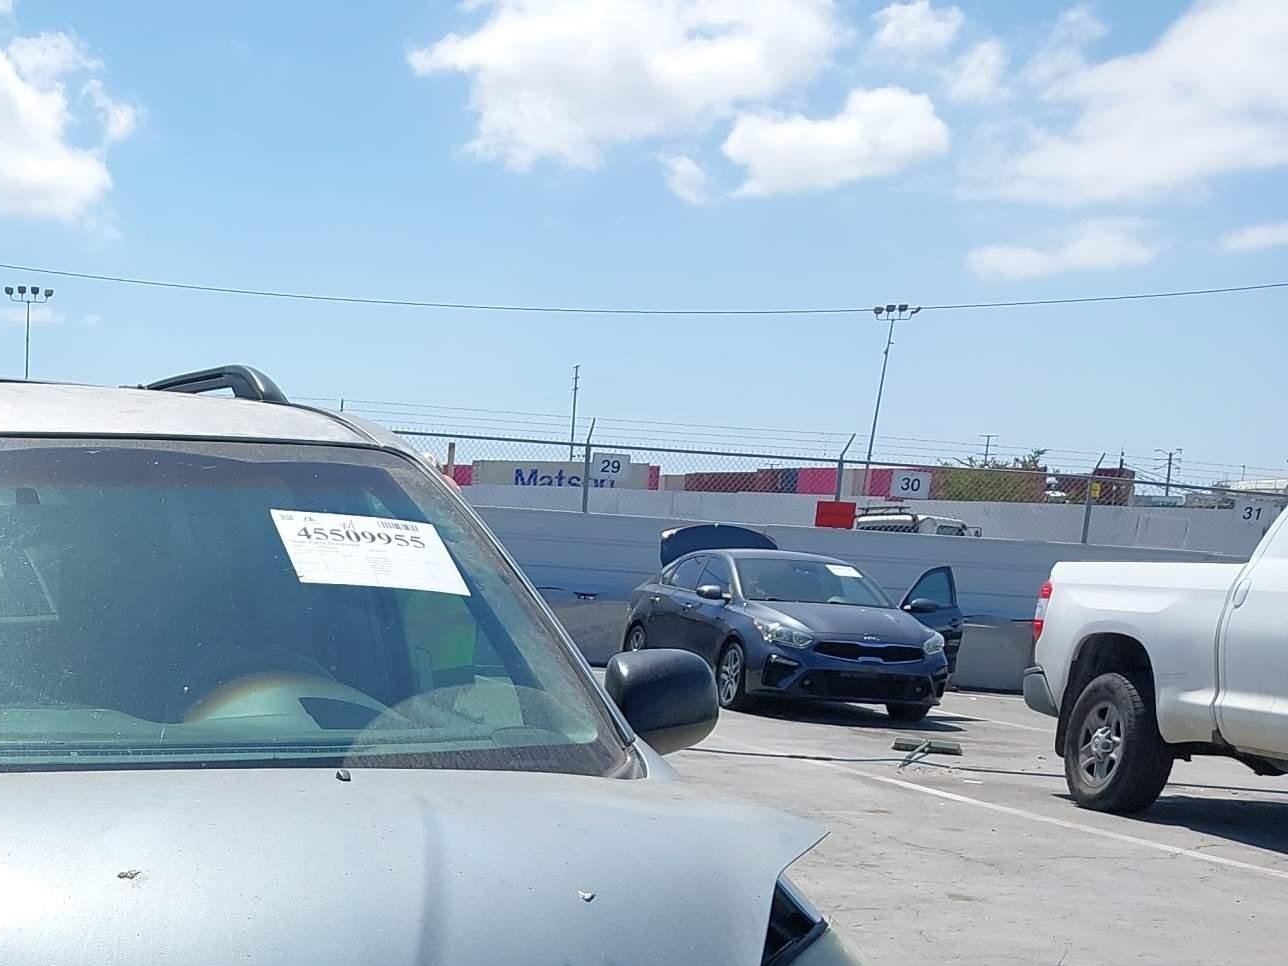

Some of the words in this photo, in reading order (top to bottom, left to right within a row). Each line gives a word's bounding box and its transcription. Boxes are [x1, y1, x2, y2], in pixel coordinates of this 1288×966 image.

[600, 459, 621, 474] 29
[900, 477, 921, 492] 30
[1242, 506, 1262, 521] 31
[297, 526, 427, 549] 45509955
